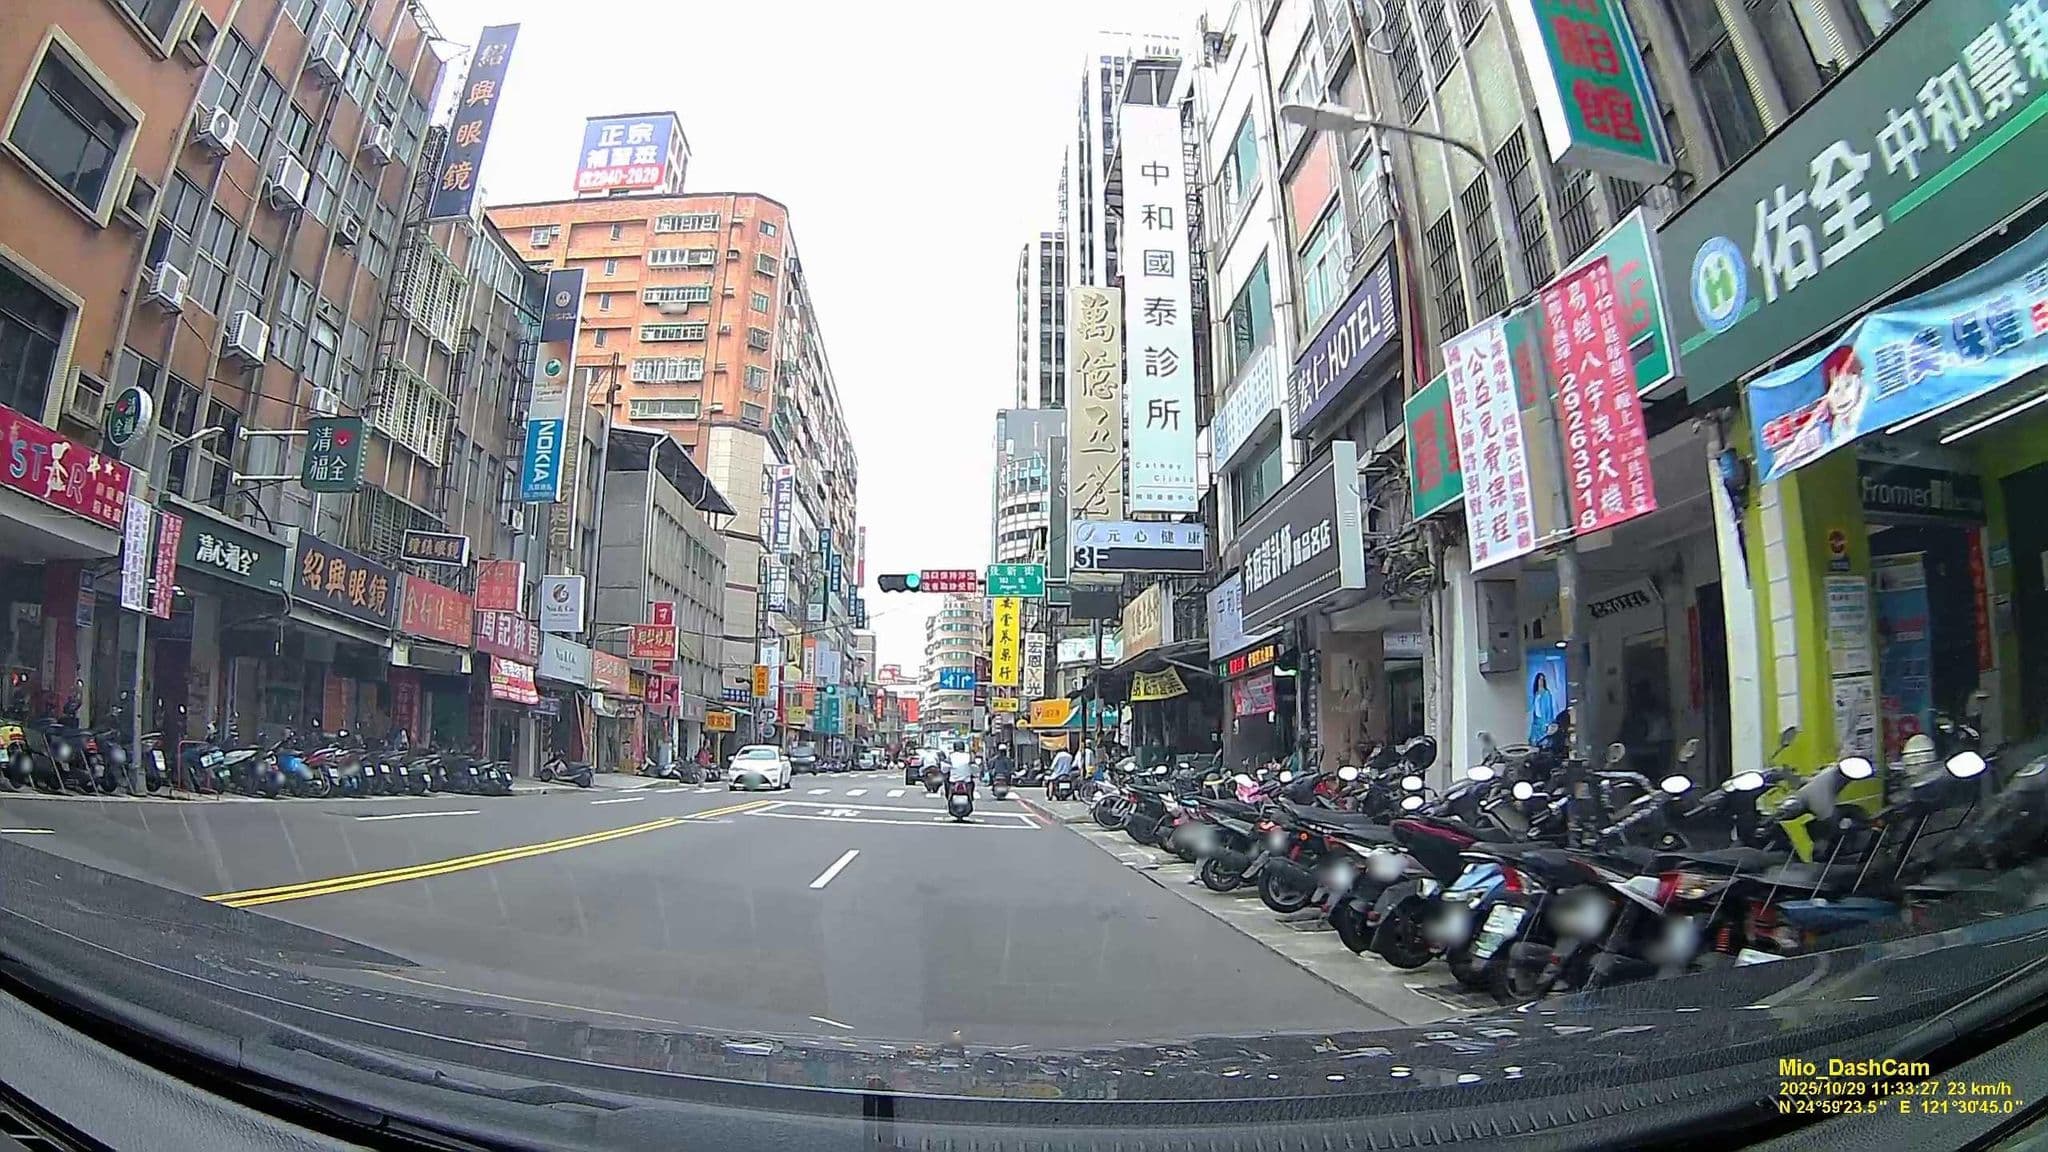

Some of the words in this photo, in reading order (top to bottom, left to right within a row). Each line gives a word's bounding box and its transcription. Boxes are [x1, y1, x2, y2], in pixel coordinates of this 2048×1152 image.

[442, 43, 507, 192] 紹興眼鏡
[597, 123, 654, 147] 正宗
[1752, 140, 1884, 300] 佑全
[1141, 160, 1181, 431] 中和國泰診所
[532, 420, 555, 482] NOKIA
[1467, 347, 1512, 545] 公益免費課程
[196, 532, 259, 577] 清心福全
[302, 548, 388, 618] 紹興眼鏡
[1075, 545, 1110, 569] 3F
[480, 610, 541, 656] 周記排骨
